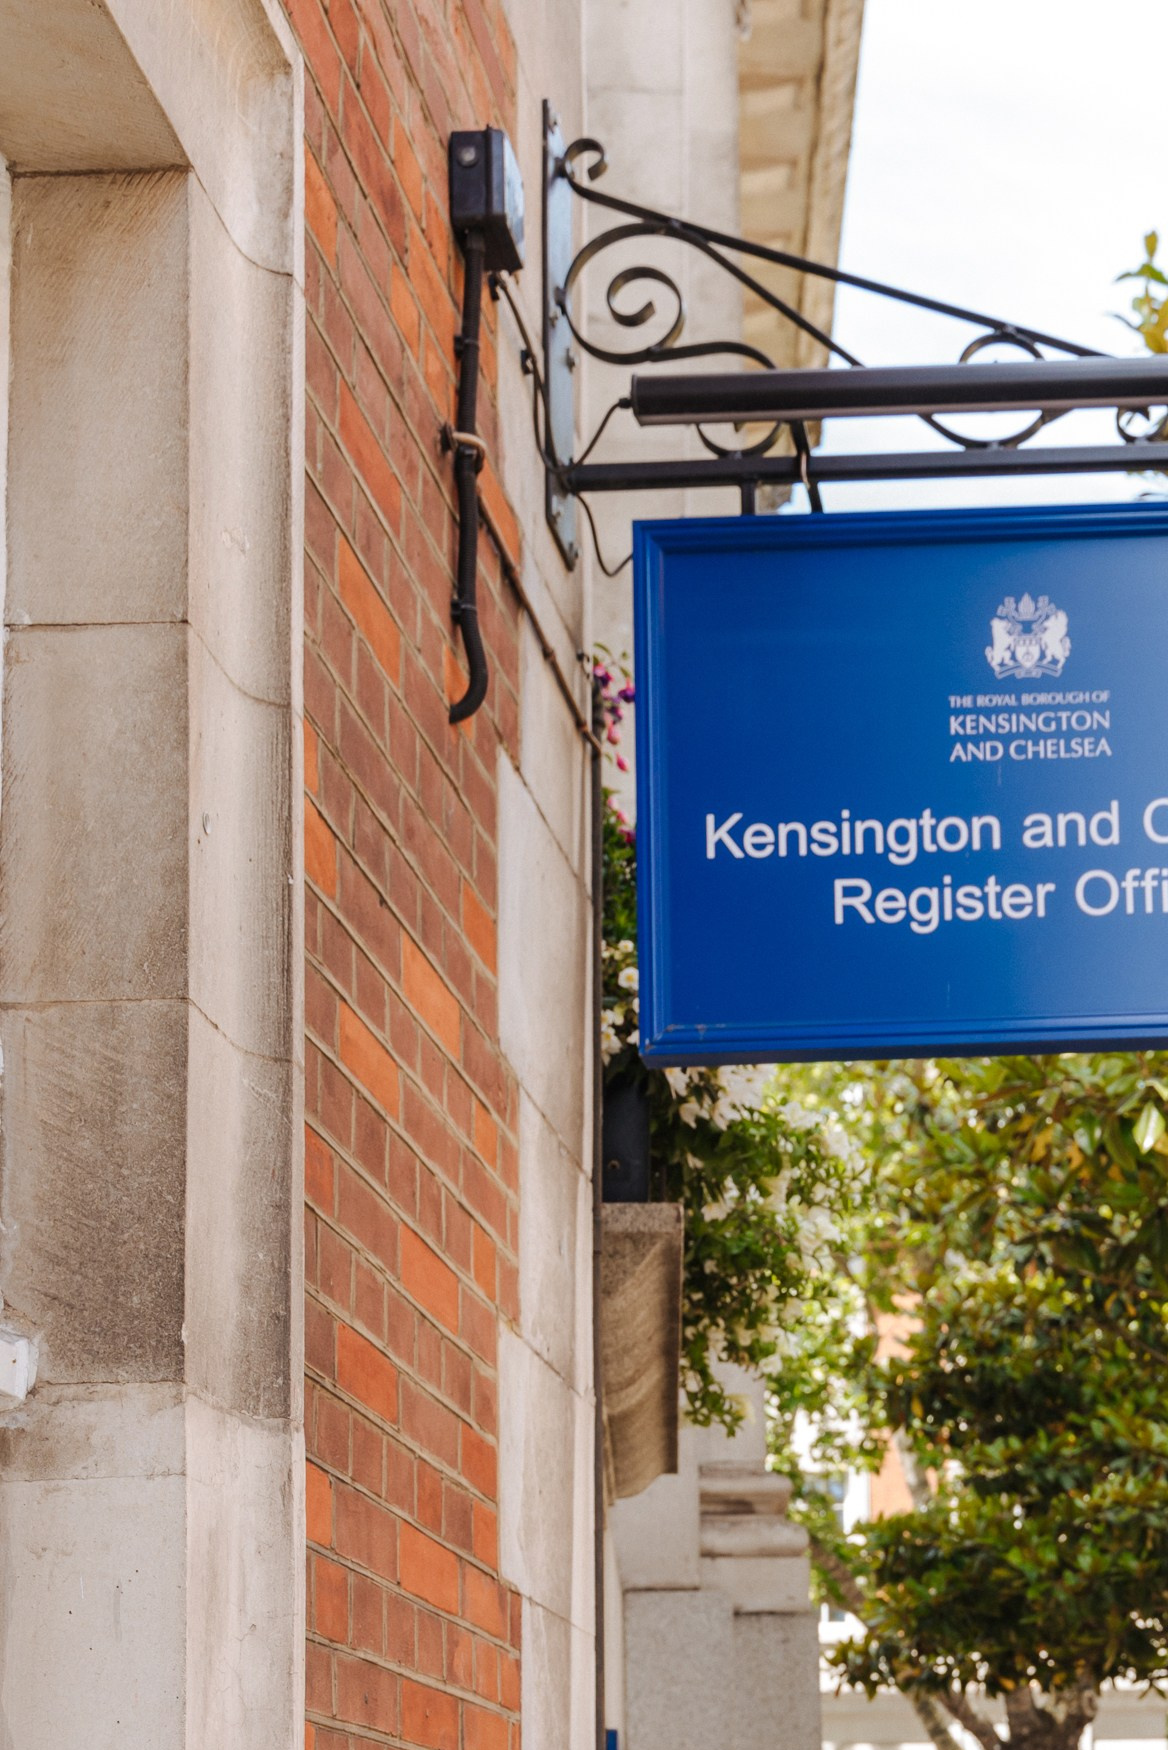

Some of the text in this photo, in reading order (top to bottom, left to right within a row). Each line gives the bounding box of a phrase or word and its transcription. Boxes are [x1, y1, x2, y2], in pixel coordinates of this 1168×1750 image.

[948, 690, 1110, 708] THE ROYAL BOROUGH OF
[949, 710, 1111, 736] KENSINGTON
[949, 737, 1113, 763] AND CHELSEA
[705, 808, 1001, 866] Kensington
[1021, 800, 1120, 849] and
[833, 875, 1056, 935] Register
